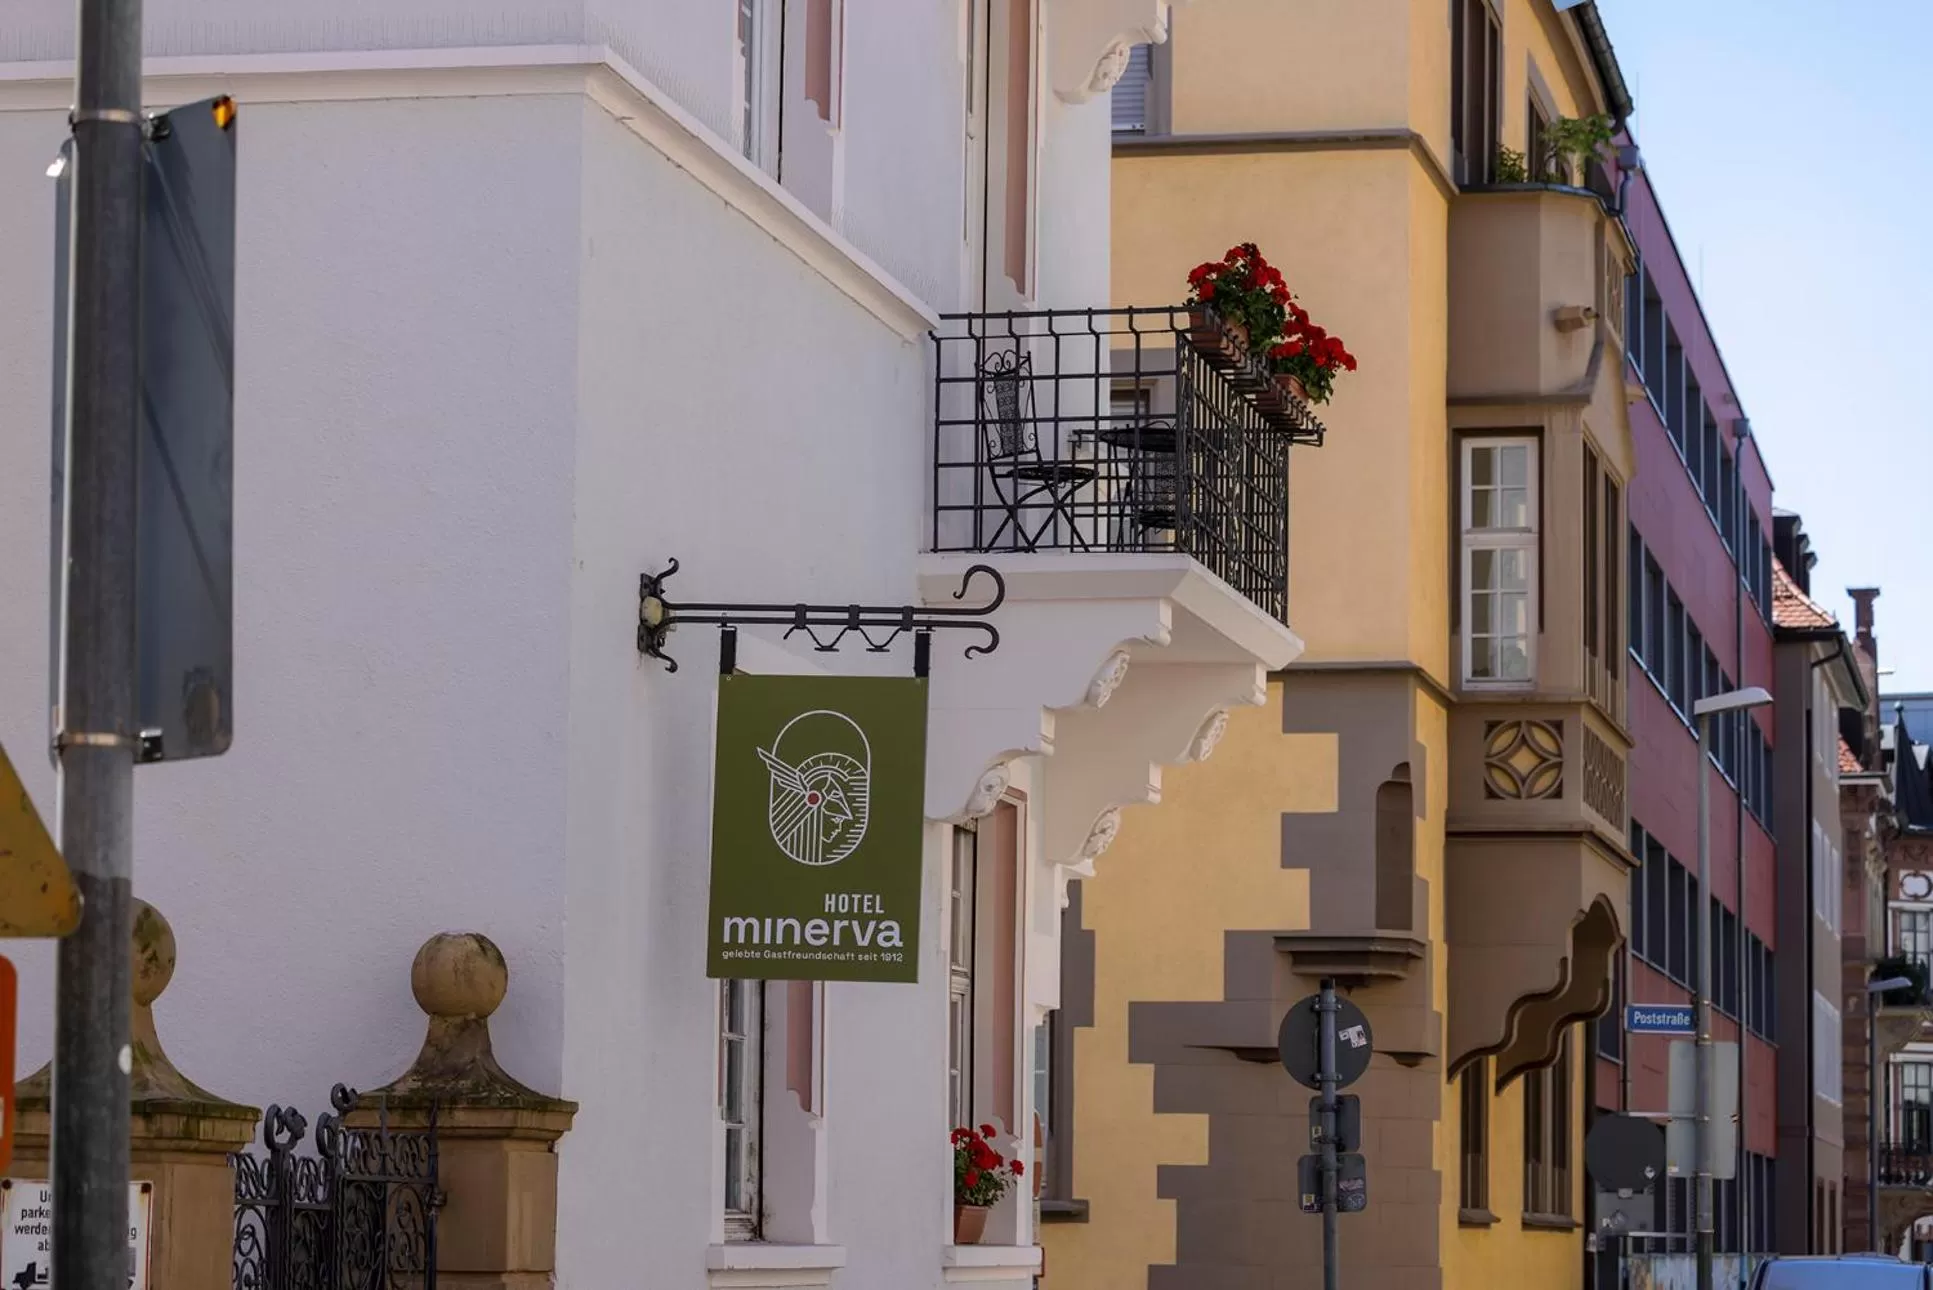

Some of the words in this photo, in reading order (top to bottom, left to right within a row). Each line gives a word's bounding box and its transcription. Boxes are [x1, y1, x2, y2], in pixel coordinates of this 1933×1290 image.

[824, 893, 885, 914] HOTEL
[722, 916, 904, 948] minerva
[722, 949, 761, 960] gelebte
[763, 949, 855, 961] Gastfreundschaft
[857, 951, 878, 961] seit
[880, 951, 904, 962] 1912
[1633, 1010, 1691, 1026] Poststraße
[21, 1205, 51, 1221] parke
[14, 1222, 51, 1235] werde
